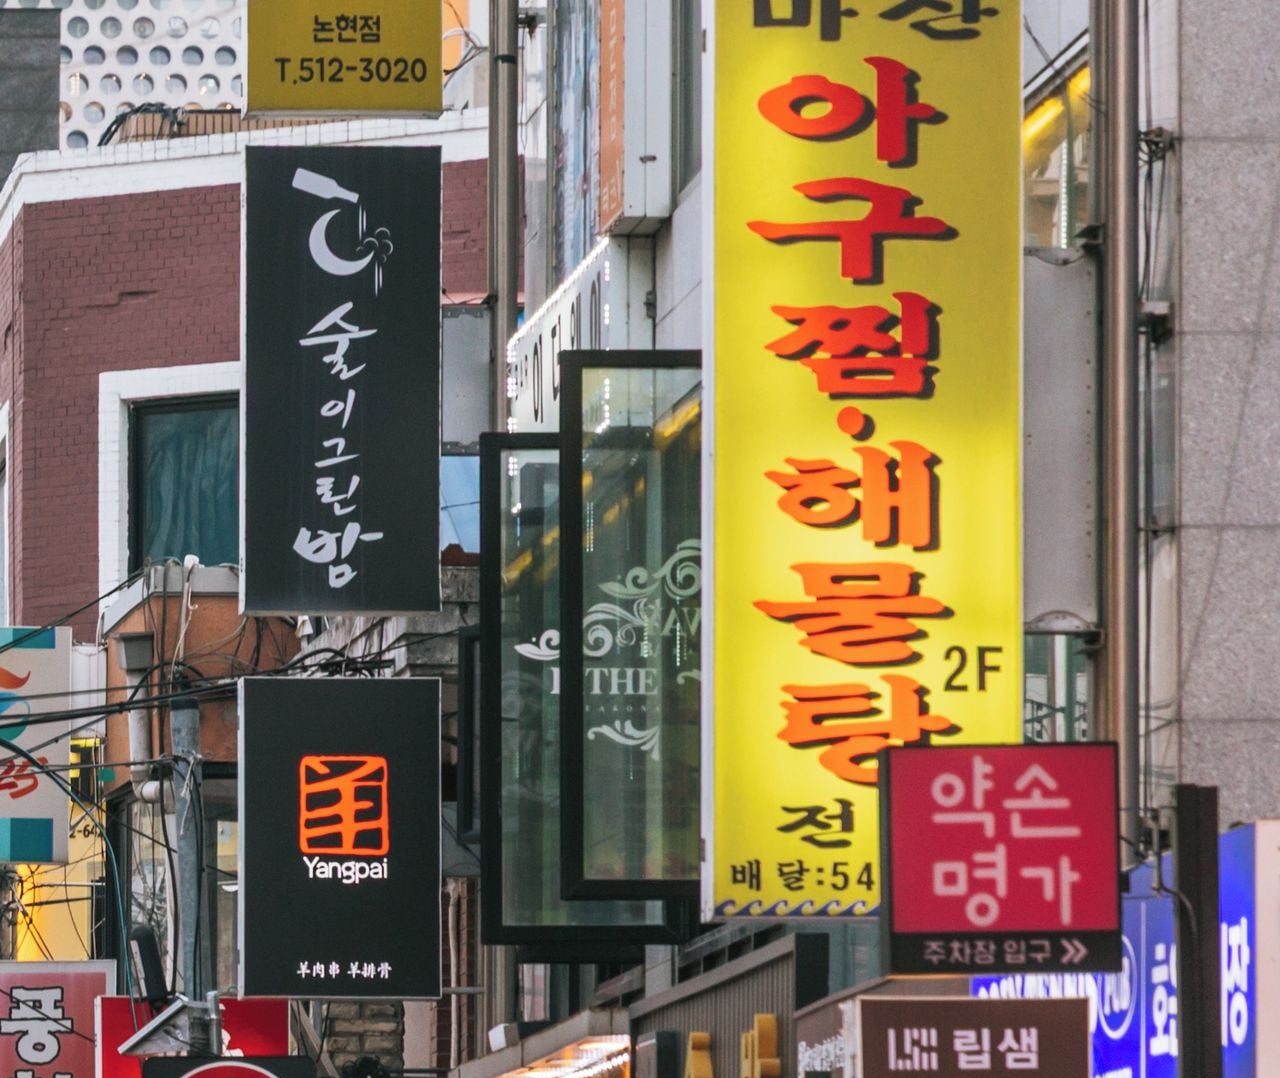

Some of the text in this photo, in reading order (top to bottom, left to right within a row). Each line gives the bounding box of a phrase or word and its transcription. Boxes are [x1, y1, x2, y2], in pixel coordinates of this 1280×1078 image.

[312, 14, 380, 43] 논현점
[275, 57, 428, 85] T.512-3020
[294, 301, 383, 588] 술이그린밤
[942, 645, 1004, 692] 2F
[931, 756, 1081, 839] 약손
[303, 855, 388, 883] Yangpai
[932, 844, 1081, 928] 명가
[924, 938, 1052, 964] 주차장 입구
[952, 1027, 1039, 1070] 립샘
